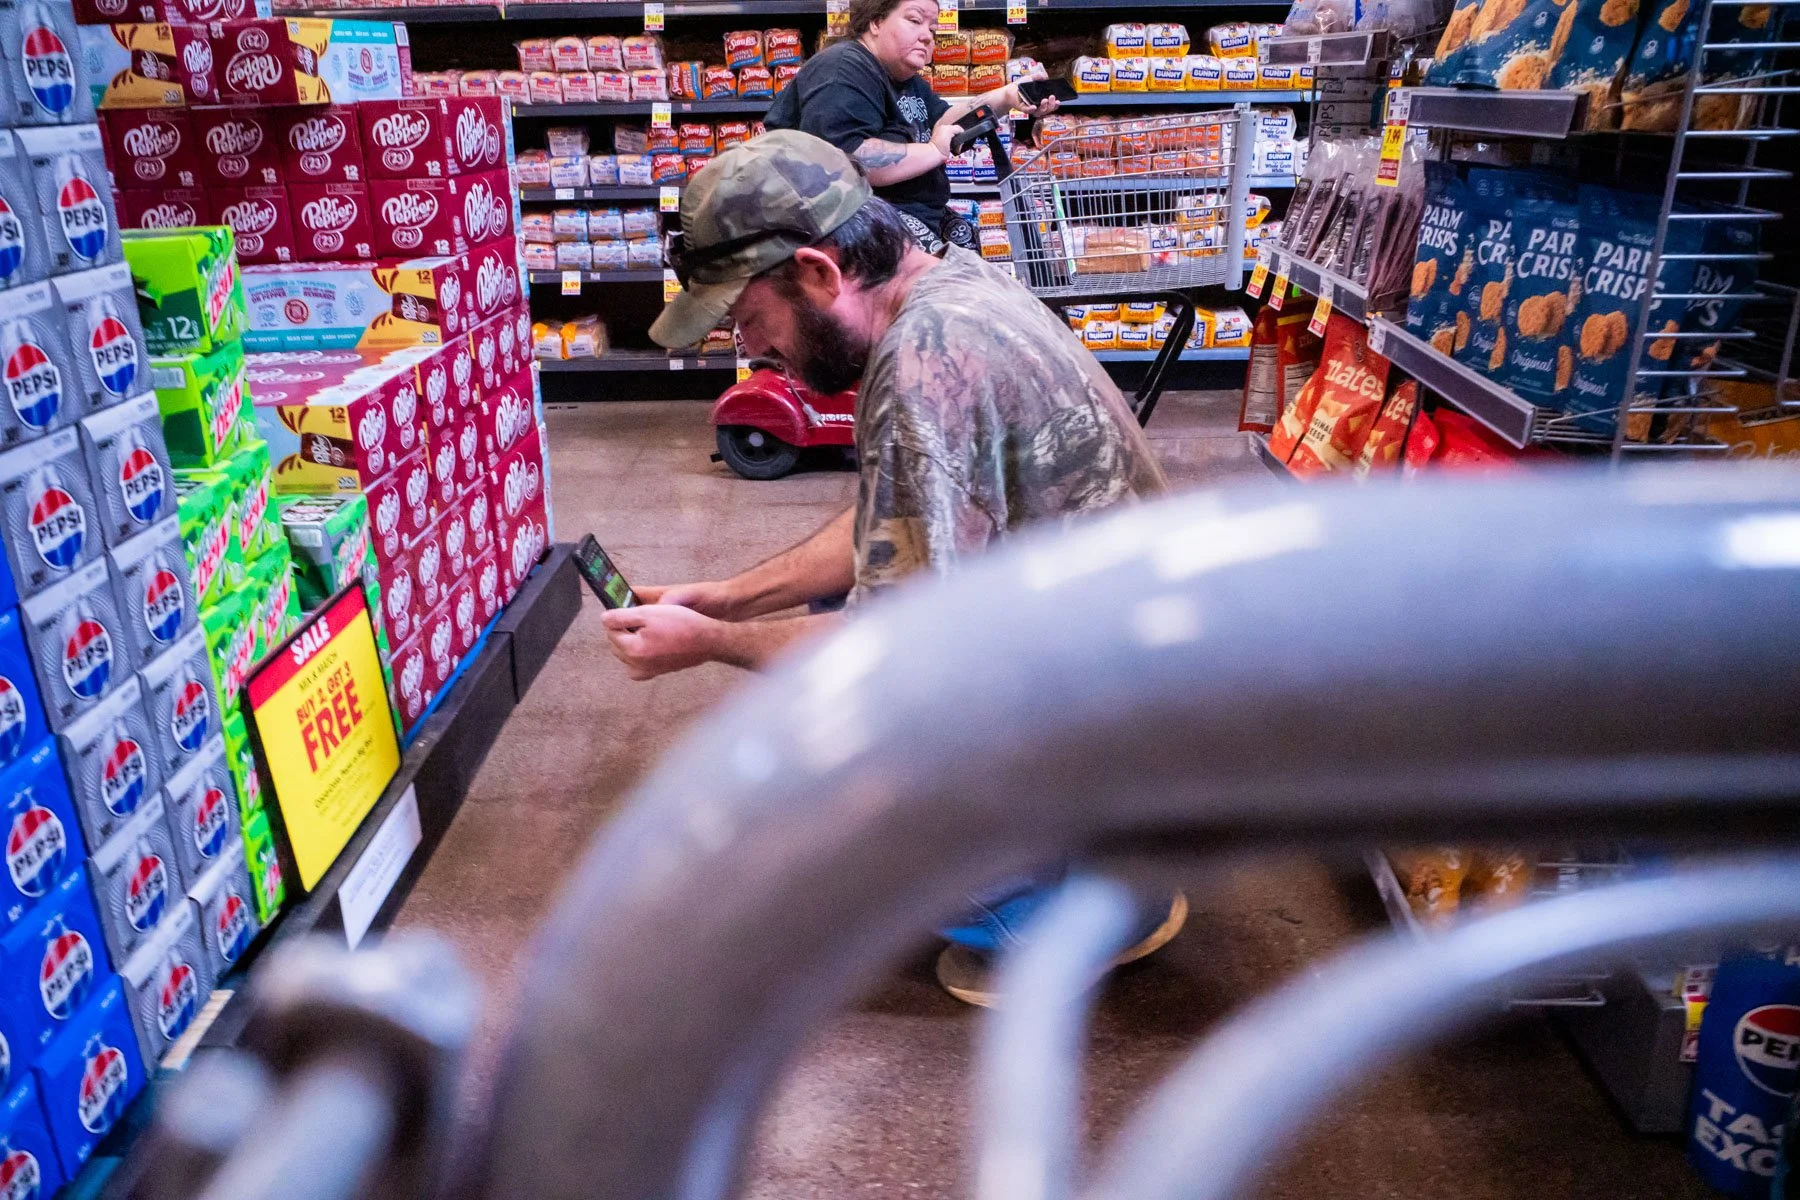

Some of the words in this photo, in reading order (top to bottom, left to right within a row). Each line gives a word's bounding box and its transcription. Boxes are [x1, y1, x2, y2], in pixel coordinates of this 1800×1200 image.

[156, 26, 170, 36] 12
[1117, 38, 1143, 46] BUNNY
[1154, 38, 1179, 46] BUNNY
[1222, 37, 1248, 48] BUNNY
[26, 58, 71, 79] PEPSI
[1083, 73, 1108, 82] BUNNY
[1117, 70, 1143, 79] BUNNY
[1156, 70, 1181, 79] BUNNY
[1193, 69, 1219, 78] BUNNY
[1228, 72, 1254, 80] BUNNY
[1264, 69, 1290, 78] BUNNY
[307, 118, 327, 133] Dr
[391, 113, 411, 129] Dr
[1264, 118, 1287, 126] BUNNY
[1318, 104, 1335, 137] POPS
[291, 123, 341, 151] Pepper
[373, 118, 425, 147] Pepper
[240, 201, 259, 216] Dr
[319, 197, 339, 212] Dr
[382, 197, 434, 226] Pepper
[400, 193, 420, 208] Dr
[64, 206, 104, 227] PEPSI
[223, 205, 273, 233] Pepper
[302, 202, 353, 229] Pepper
[1423, 205, 1463, 230] PARM
[1417, 224, 1458, 256] CRISPS
[1593, 241, 1665, 278] PARM
[416, 270, 431, 281] 12
[1584, 266, 1665, 311] CRISPS
[167, 316, 194, 339] 12
[1088, 331, 1112, 339] BUNNY
[96, 344, 134, 368] PEPSI
[1511, 347, 1554, 374] Original
[11, 372, 57, 396] PEPSI
[1324, 359, 1384, 401] nates
[329, 408, 345, 419] 12
[127, 469, 160, 497] PEPSI
[37, 510, 81, 543] PEPSI
[147, 587, 180, 616] PEPSI
[290, 616, 331, 666] SALE
[67, 642, 109, 676] PEPSI
[301, 678, 363, 774] FREE
[13, 827, 62, 876] PEPSI
